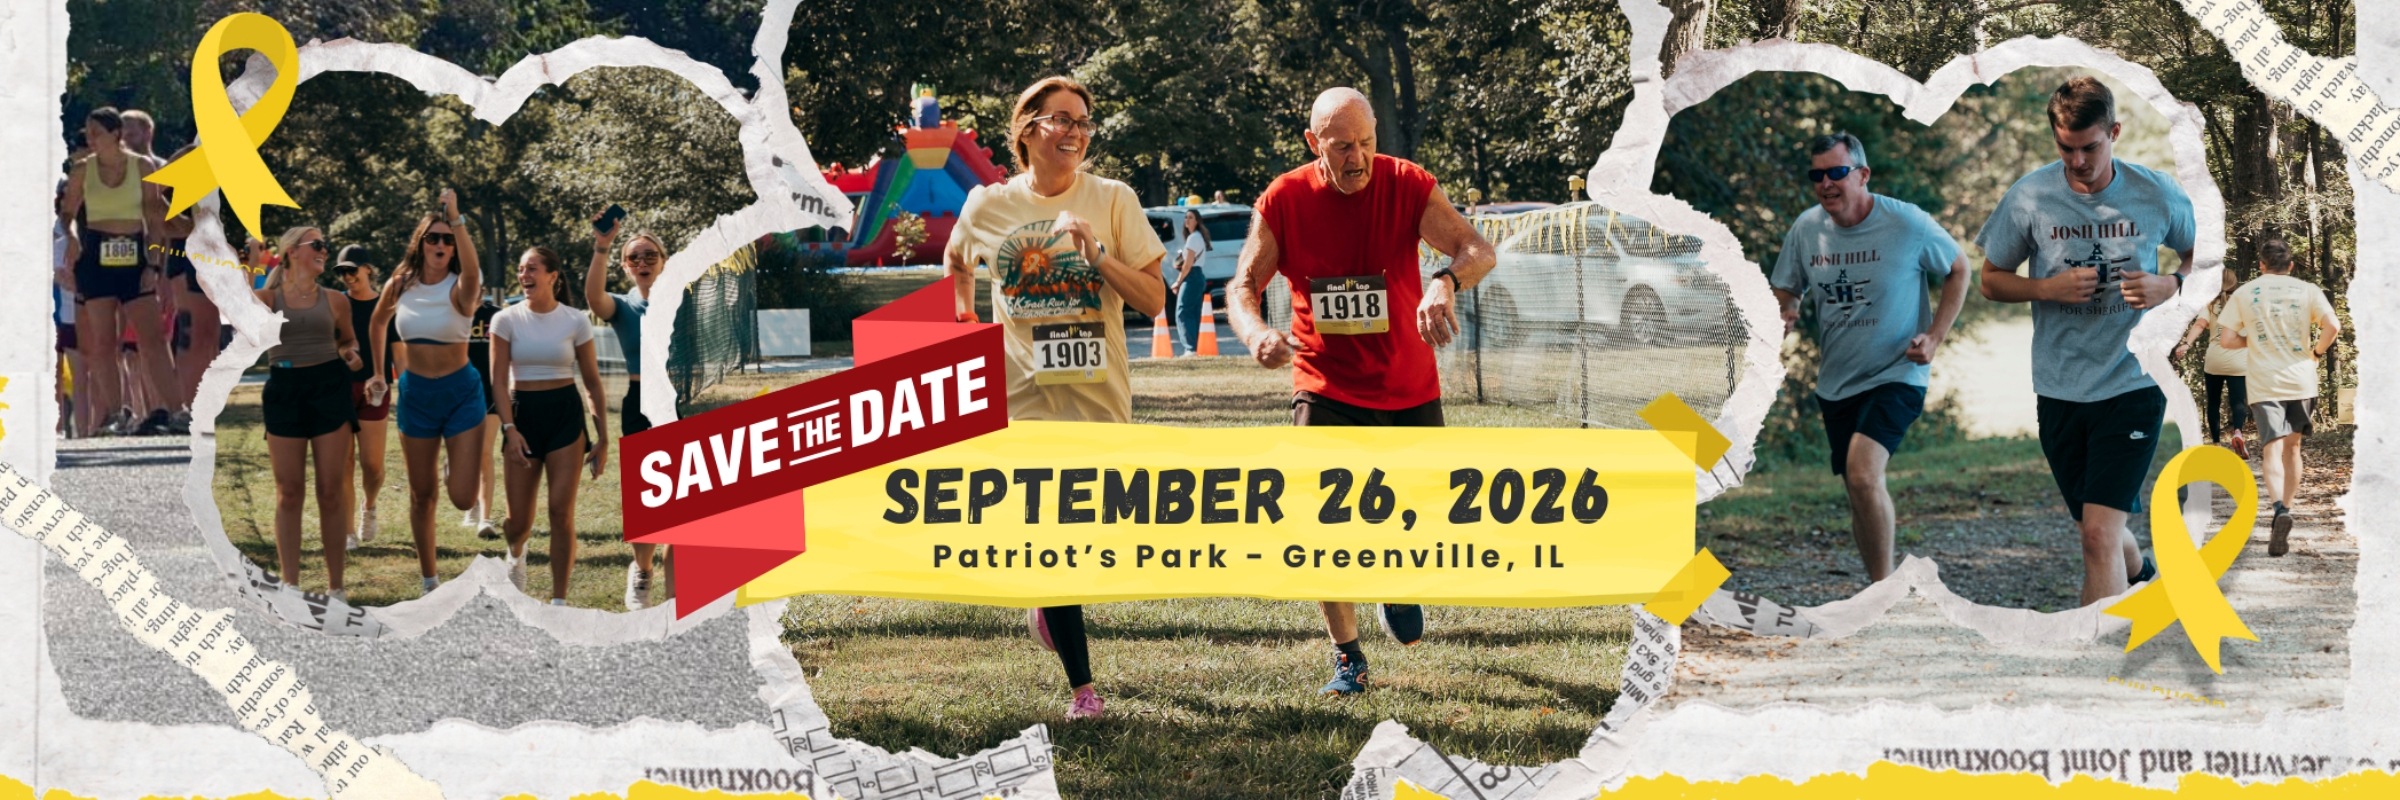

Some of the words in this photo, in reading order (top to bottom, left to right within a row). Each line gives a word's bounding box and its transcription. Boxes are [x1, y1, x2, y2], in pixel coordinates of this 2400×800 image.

[2253, 46, 2271, 68] all
[2265, 43, 2302, 83] ating,
[2290, 60, 2325, 97] night
[2319, 62, 2358, 99] watch
[2346, 97, 2393, 143] lackth
[2050, 225, 2093, 240] JOSH
[2098, 222, 2140, 239] HILL
[1810, 253, 1840, 267] JOSH
[1845, 249, 1880, 264] HILL
[1048, 298, 1065, 308] Run
[1320, 293, 1380, 319] 1918
[1042, 341, 1101, 368] 1903
[131, 597, 149, 619] all
[143, 593, 184, 634] ating,
[168, 611, 203, 648] night
[197, 613, 241, 651] watch
[225, 649, 271, 695] lackth
[1627, 661, 1656, 683] grid
[273, 697, 290, 718] of
[346, 754, 369, 778] out
[975, 761, 991, 777] 20
[2061, 748, 2132, 782] Joint
[2138, 748, 2194, 783] and
[2202, 749, 2332, 779] erwriter
